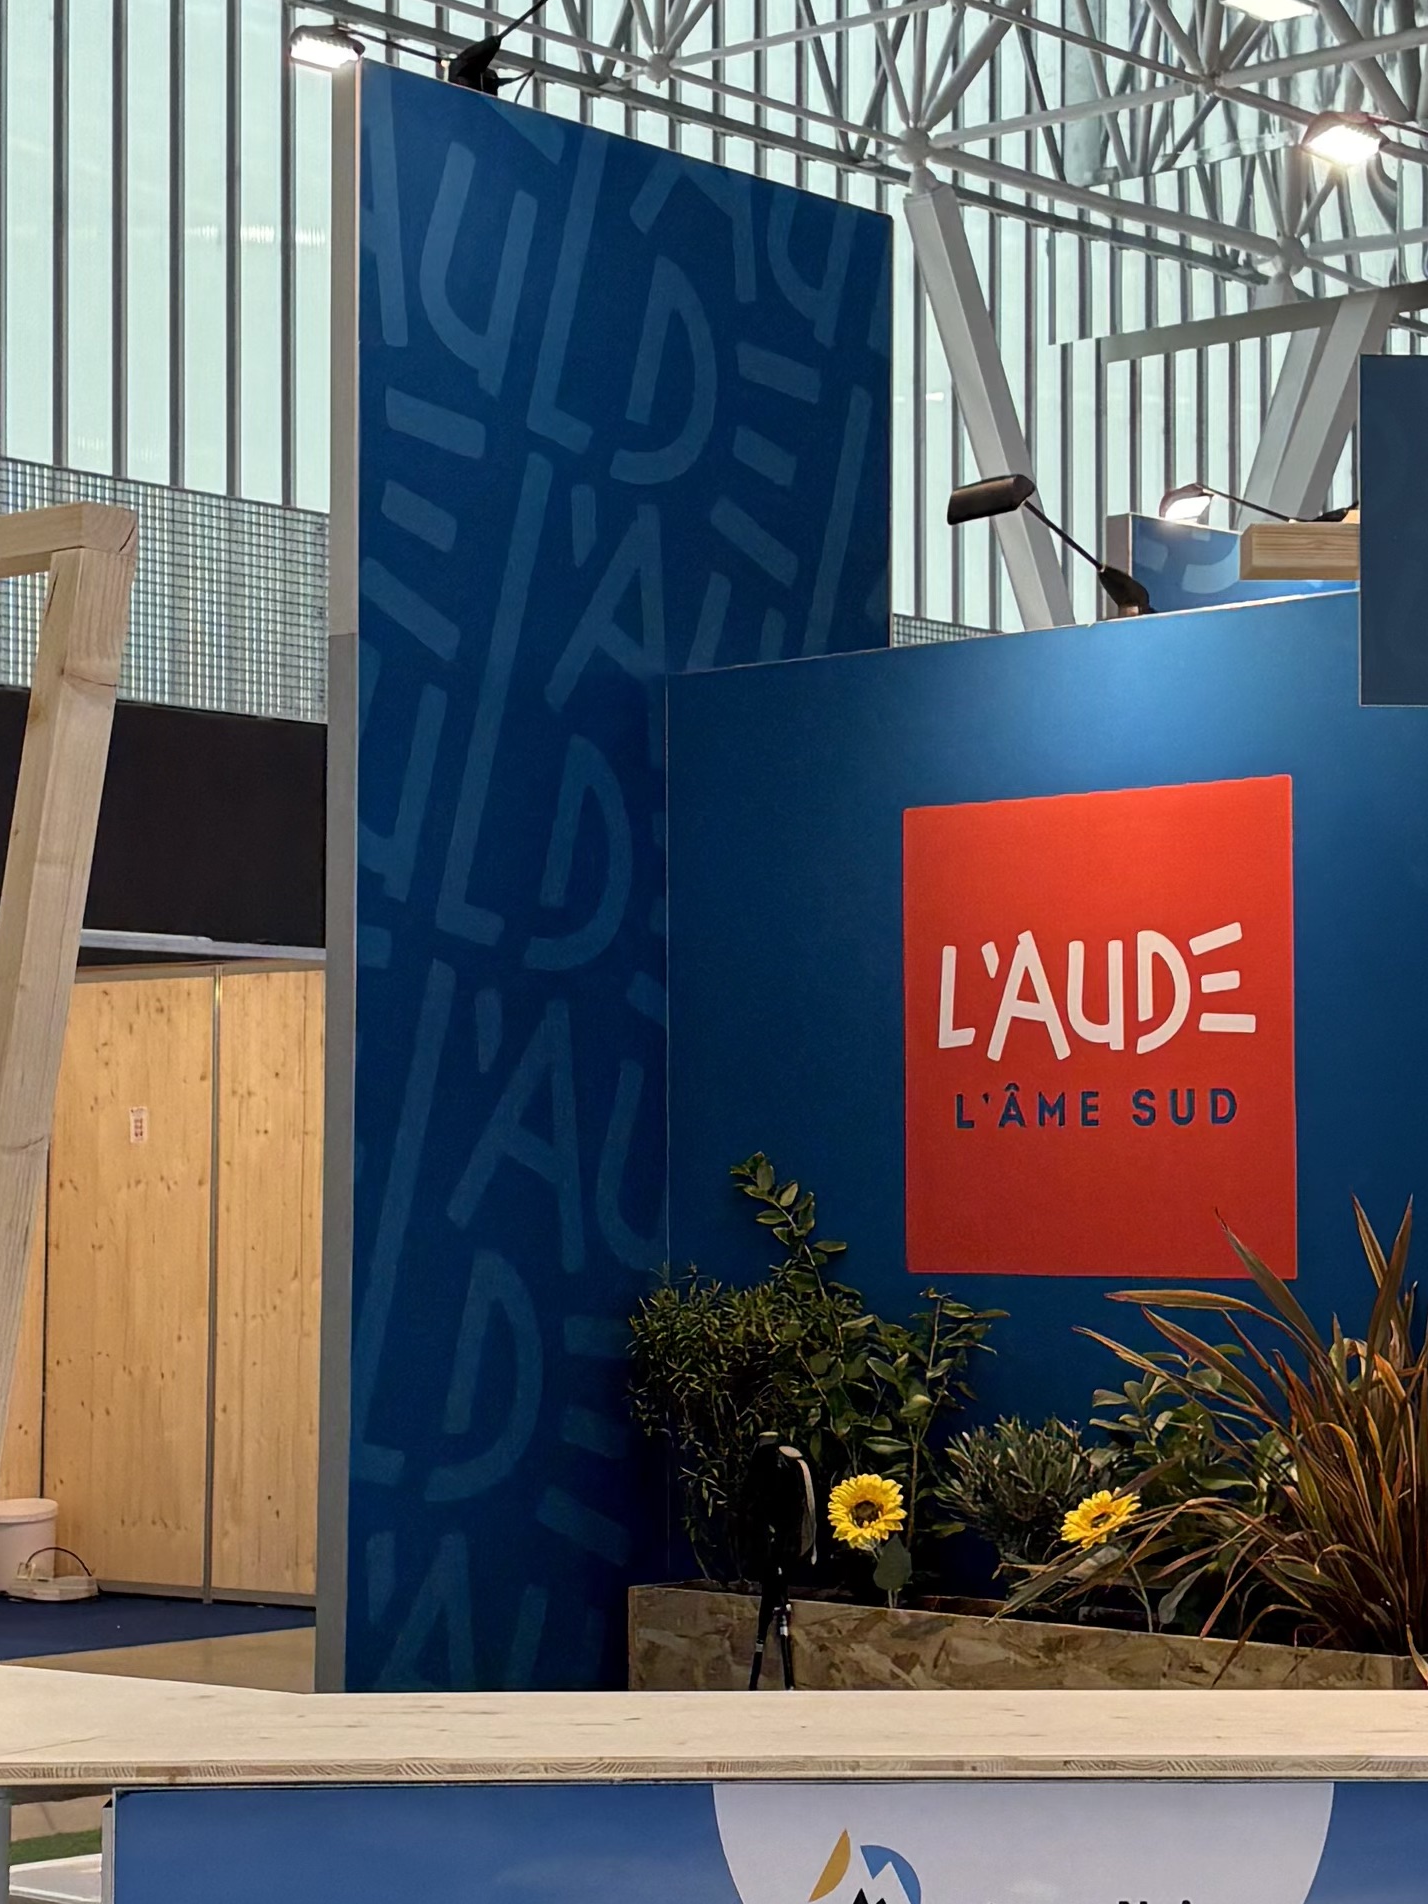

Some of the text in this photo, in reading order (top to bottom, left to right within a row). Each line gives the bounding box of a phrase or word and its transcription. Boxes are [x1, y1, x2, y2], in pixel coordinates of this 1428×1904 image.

[938, 921, 1257, 1062] L'AUDE
[955, 1082, 1239, 1131] L'ÂME SUD
